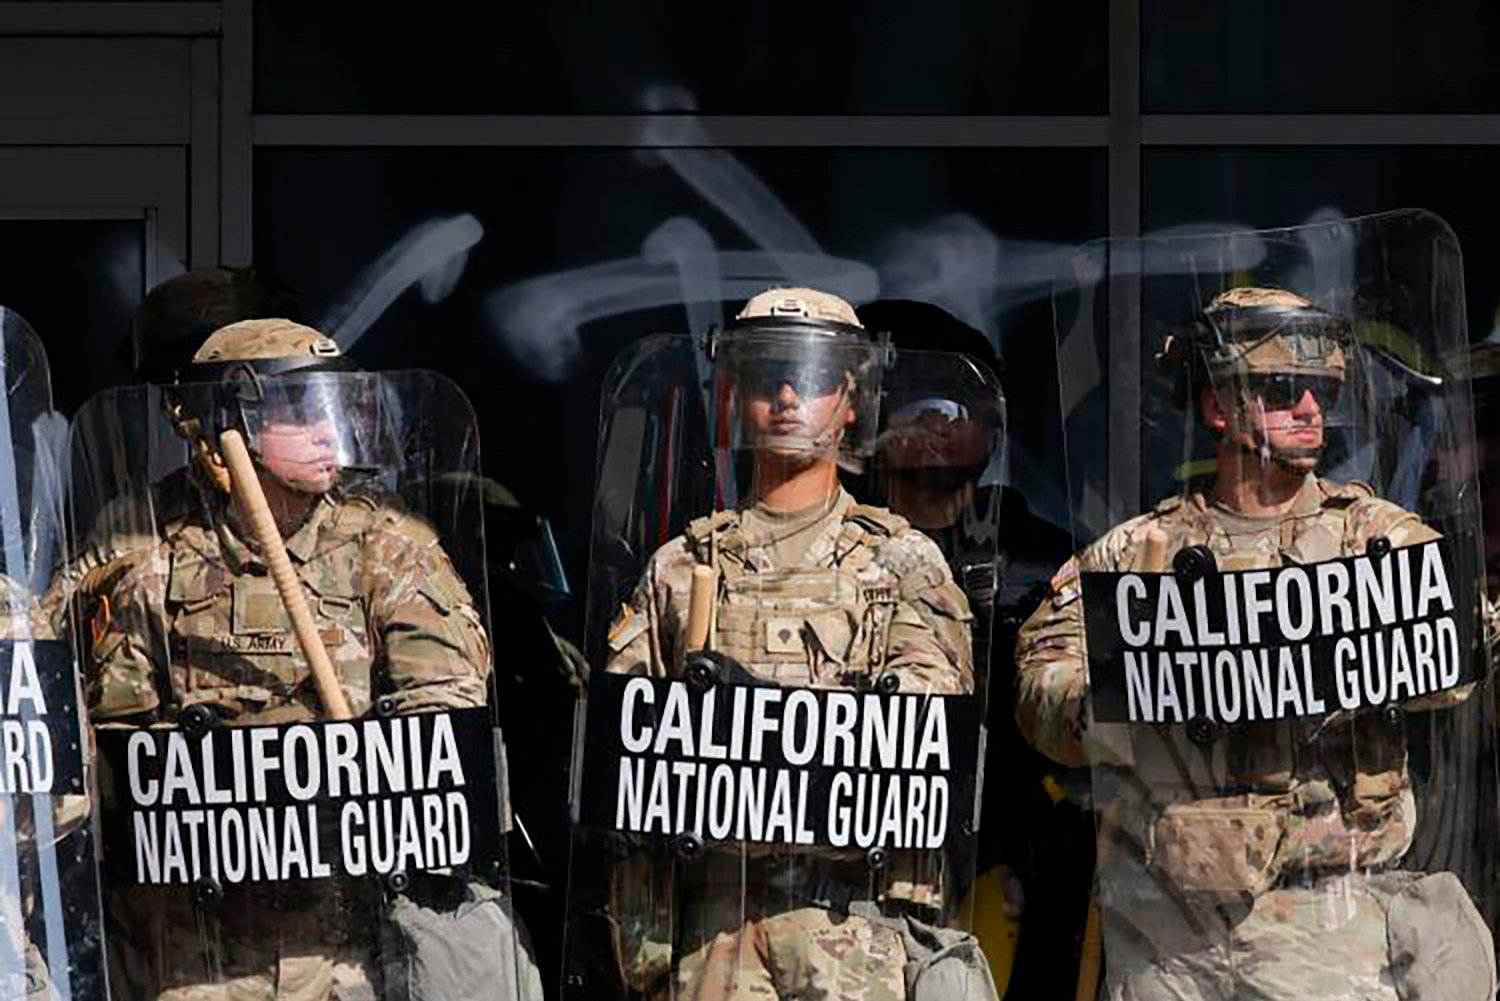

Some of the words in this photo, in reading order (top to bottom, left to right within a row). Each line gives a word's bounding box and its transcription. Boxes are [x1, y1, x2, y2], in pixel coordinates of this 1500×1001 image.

[1116, 541, 1455, 647] CALIFORNIA
[0, 640, 48, 715] A
[1123, 643, 1326, 723] NATIONAL
[1335, 616, 1460, 710] GUARD
[127, 713, 466, 806] CALIFORNIA
[620, 677, 951, 771] CALIFORNIA
[133, 804, 332, 886] NATIONAL
[340, 791, 471, 876] GUARD
[615, 756, 815, 845] NATIONAL
[827, 771, 949, 850] GUARD
